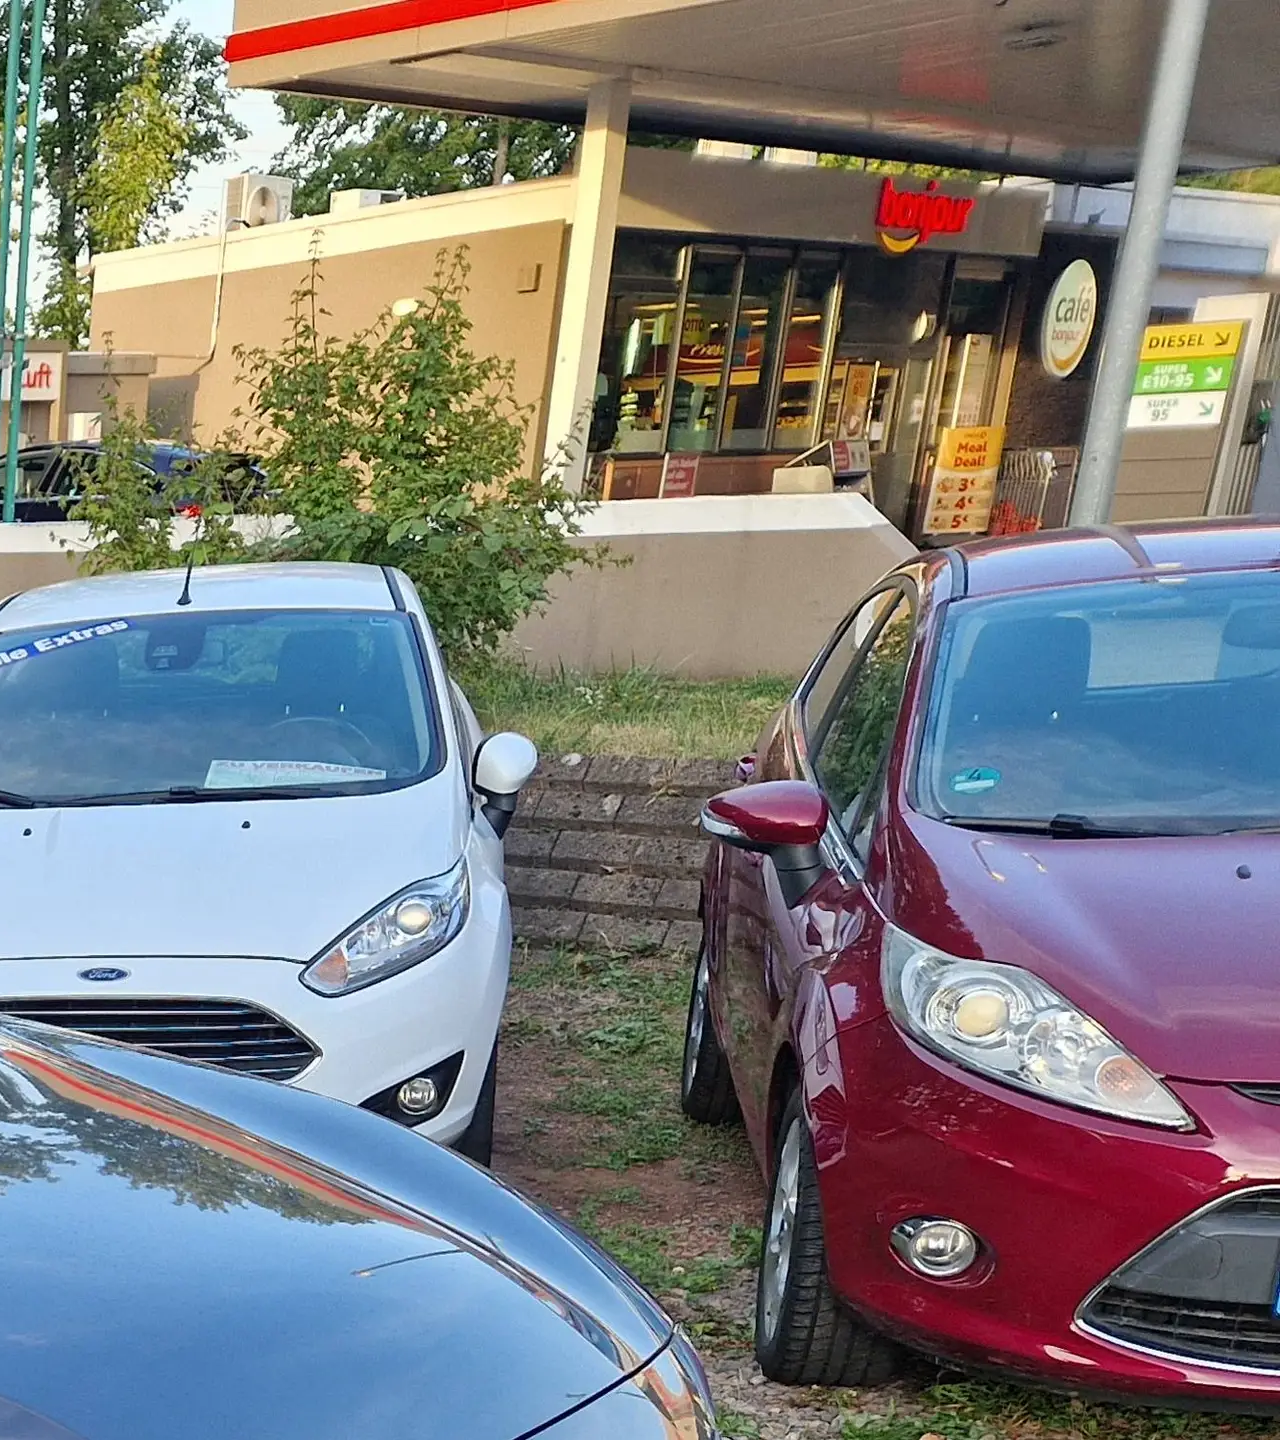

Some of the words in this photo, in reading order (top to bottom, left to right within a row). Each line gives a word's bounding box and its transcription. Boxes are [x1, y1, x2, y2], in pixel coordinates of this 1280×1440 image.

[876, 177, 976, 243] bonjour
[1055, 286, 1090, 323] café
[1148, 333, 1205, 349] DIESEL
[1154, 363, 1188, 374] SUPER
[1142, 373, 1194, 389] E10-95
[1147, 398, 1179, 409] SUPER
[1151, 409, 1169, 421] 95
[957, 441, 988, 454] Meal
[954, 455, 986, 468] Deal!
[33, 619, 129, 652] Extras
[968, 769, 981, 781] 4
[88, 967, 118, 980] Ford
